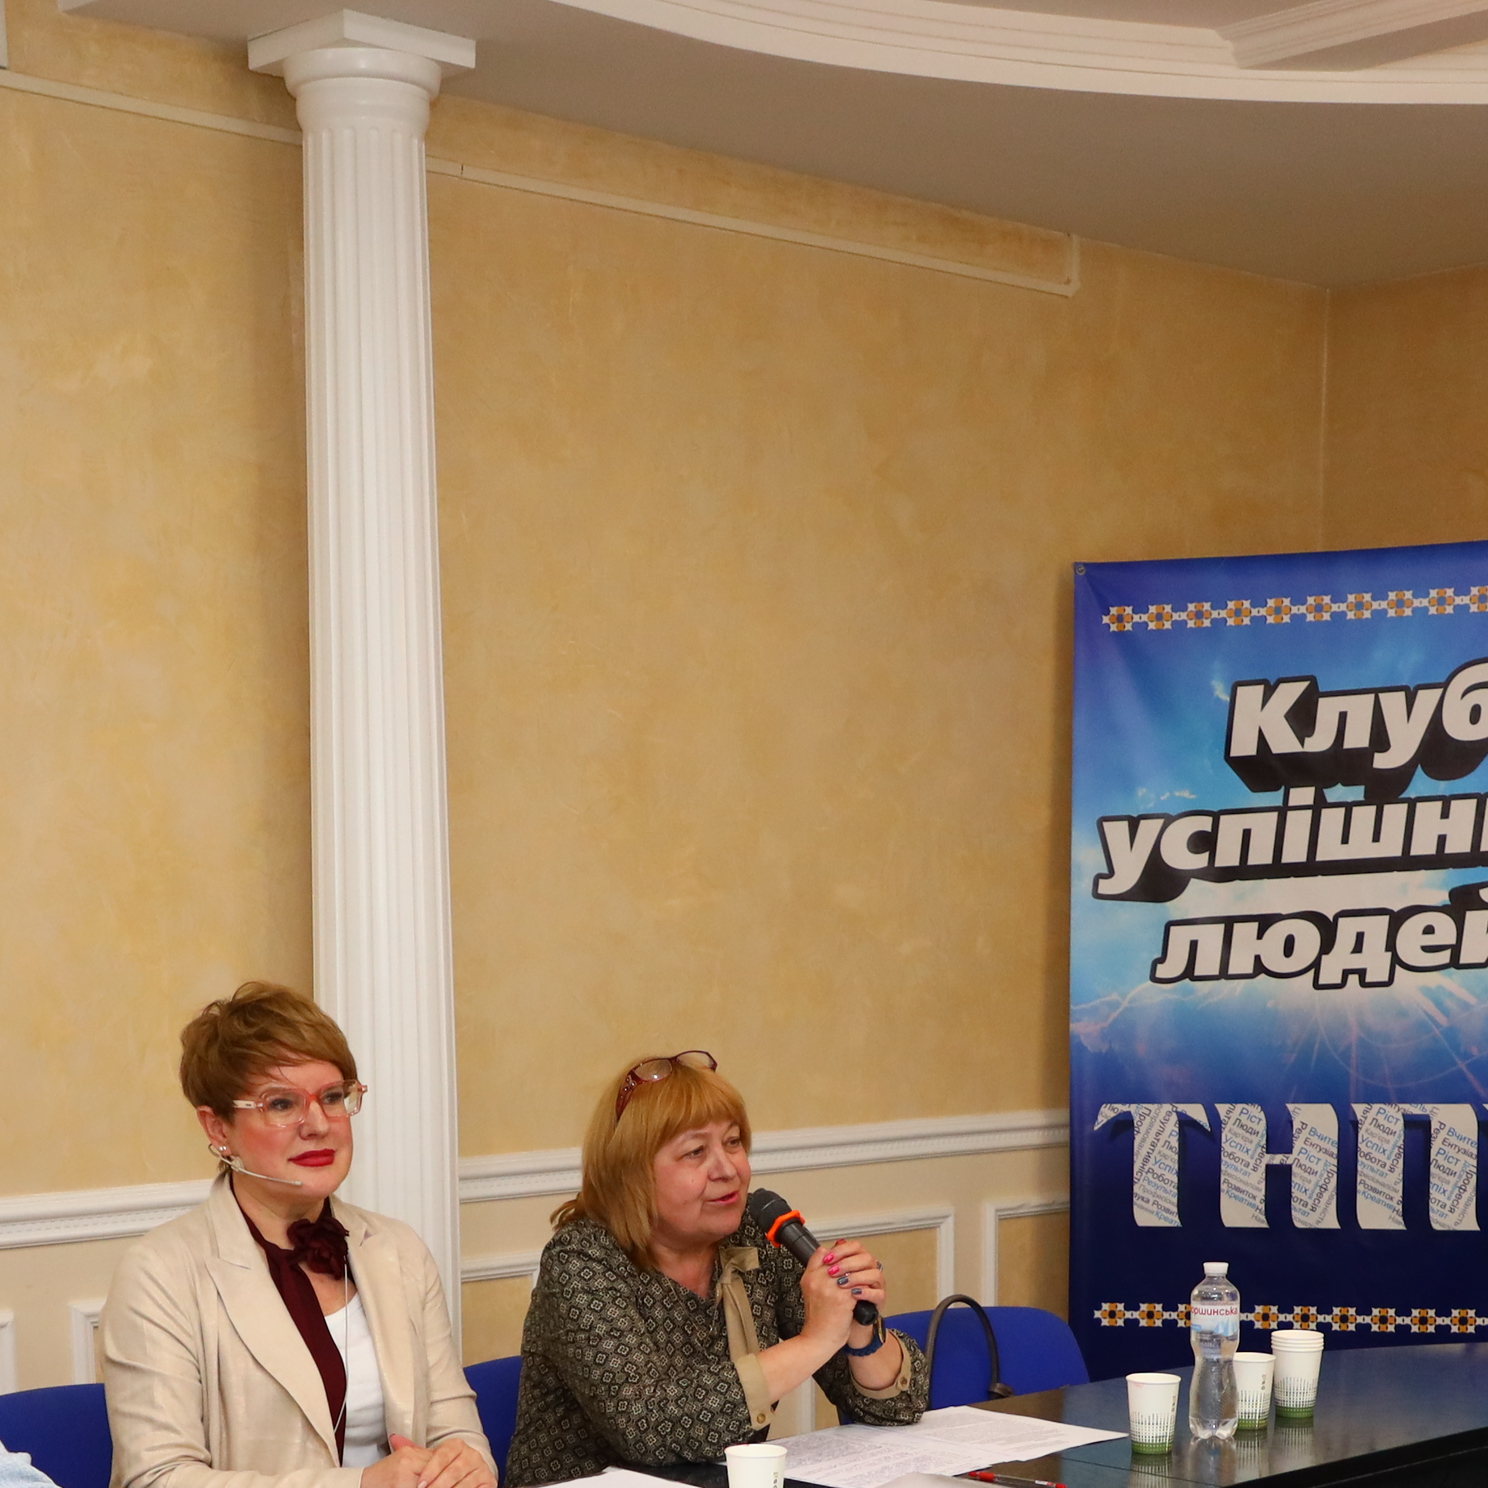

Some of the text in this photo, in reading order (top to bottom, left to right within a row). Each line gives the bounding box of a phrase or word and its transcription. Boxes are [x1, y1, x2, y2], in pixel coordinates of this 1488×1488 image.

[1238, 1107, 1263, 1125] Ріст
[1376, 1106, 1401, 1126] Ріст
[1232, 1118, 1259, 1137] Люди
[1369, 1118, 1397, 1137] Люди
[1223, 1134, 1251, 1155] Успіх
[1360, 1134, 1388, 1156] Успіх
[1296, 1147, 1322, 1166] Ріст
[1435, 1147, 1461, 1167] Ріст
[1292, 1158, 1318, 1177] Люди
[1430, 1158, 1457, 1178] Люди
[1222, 1178, 1258, 1201] Розвиток
[1358, 1179, 1396, 1202] Розвиток
